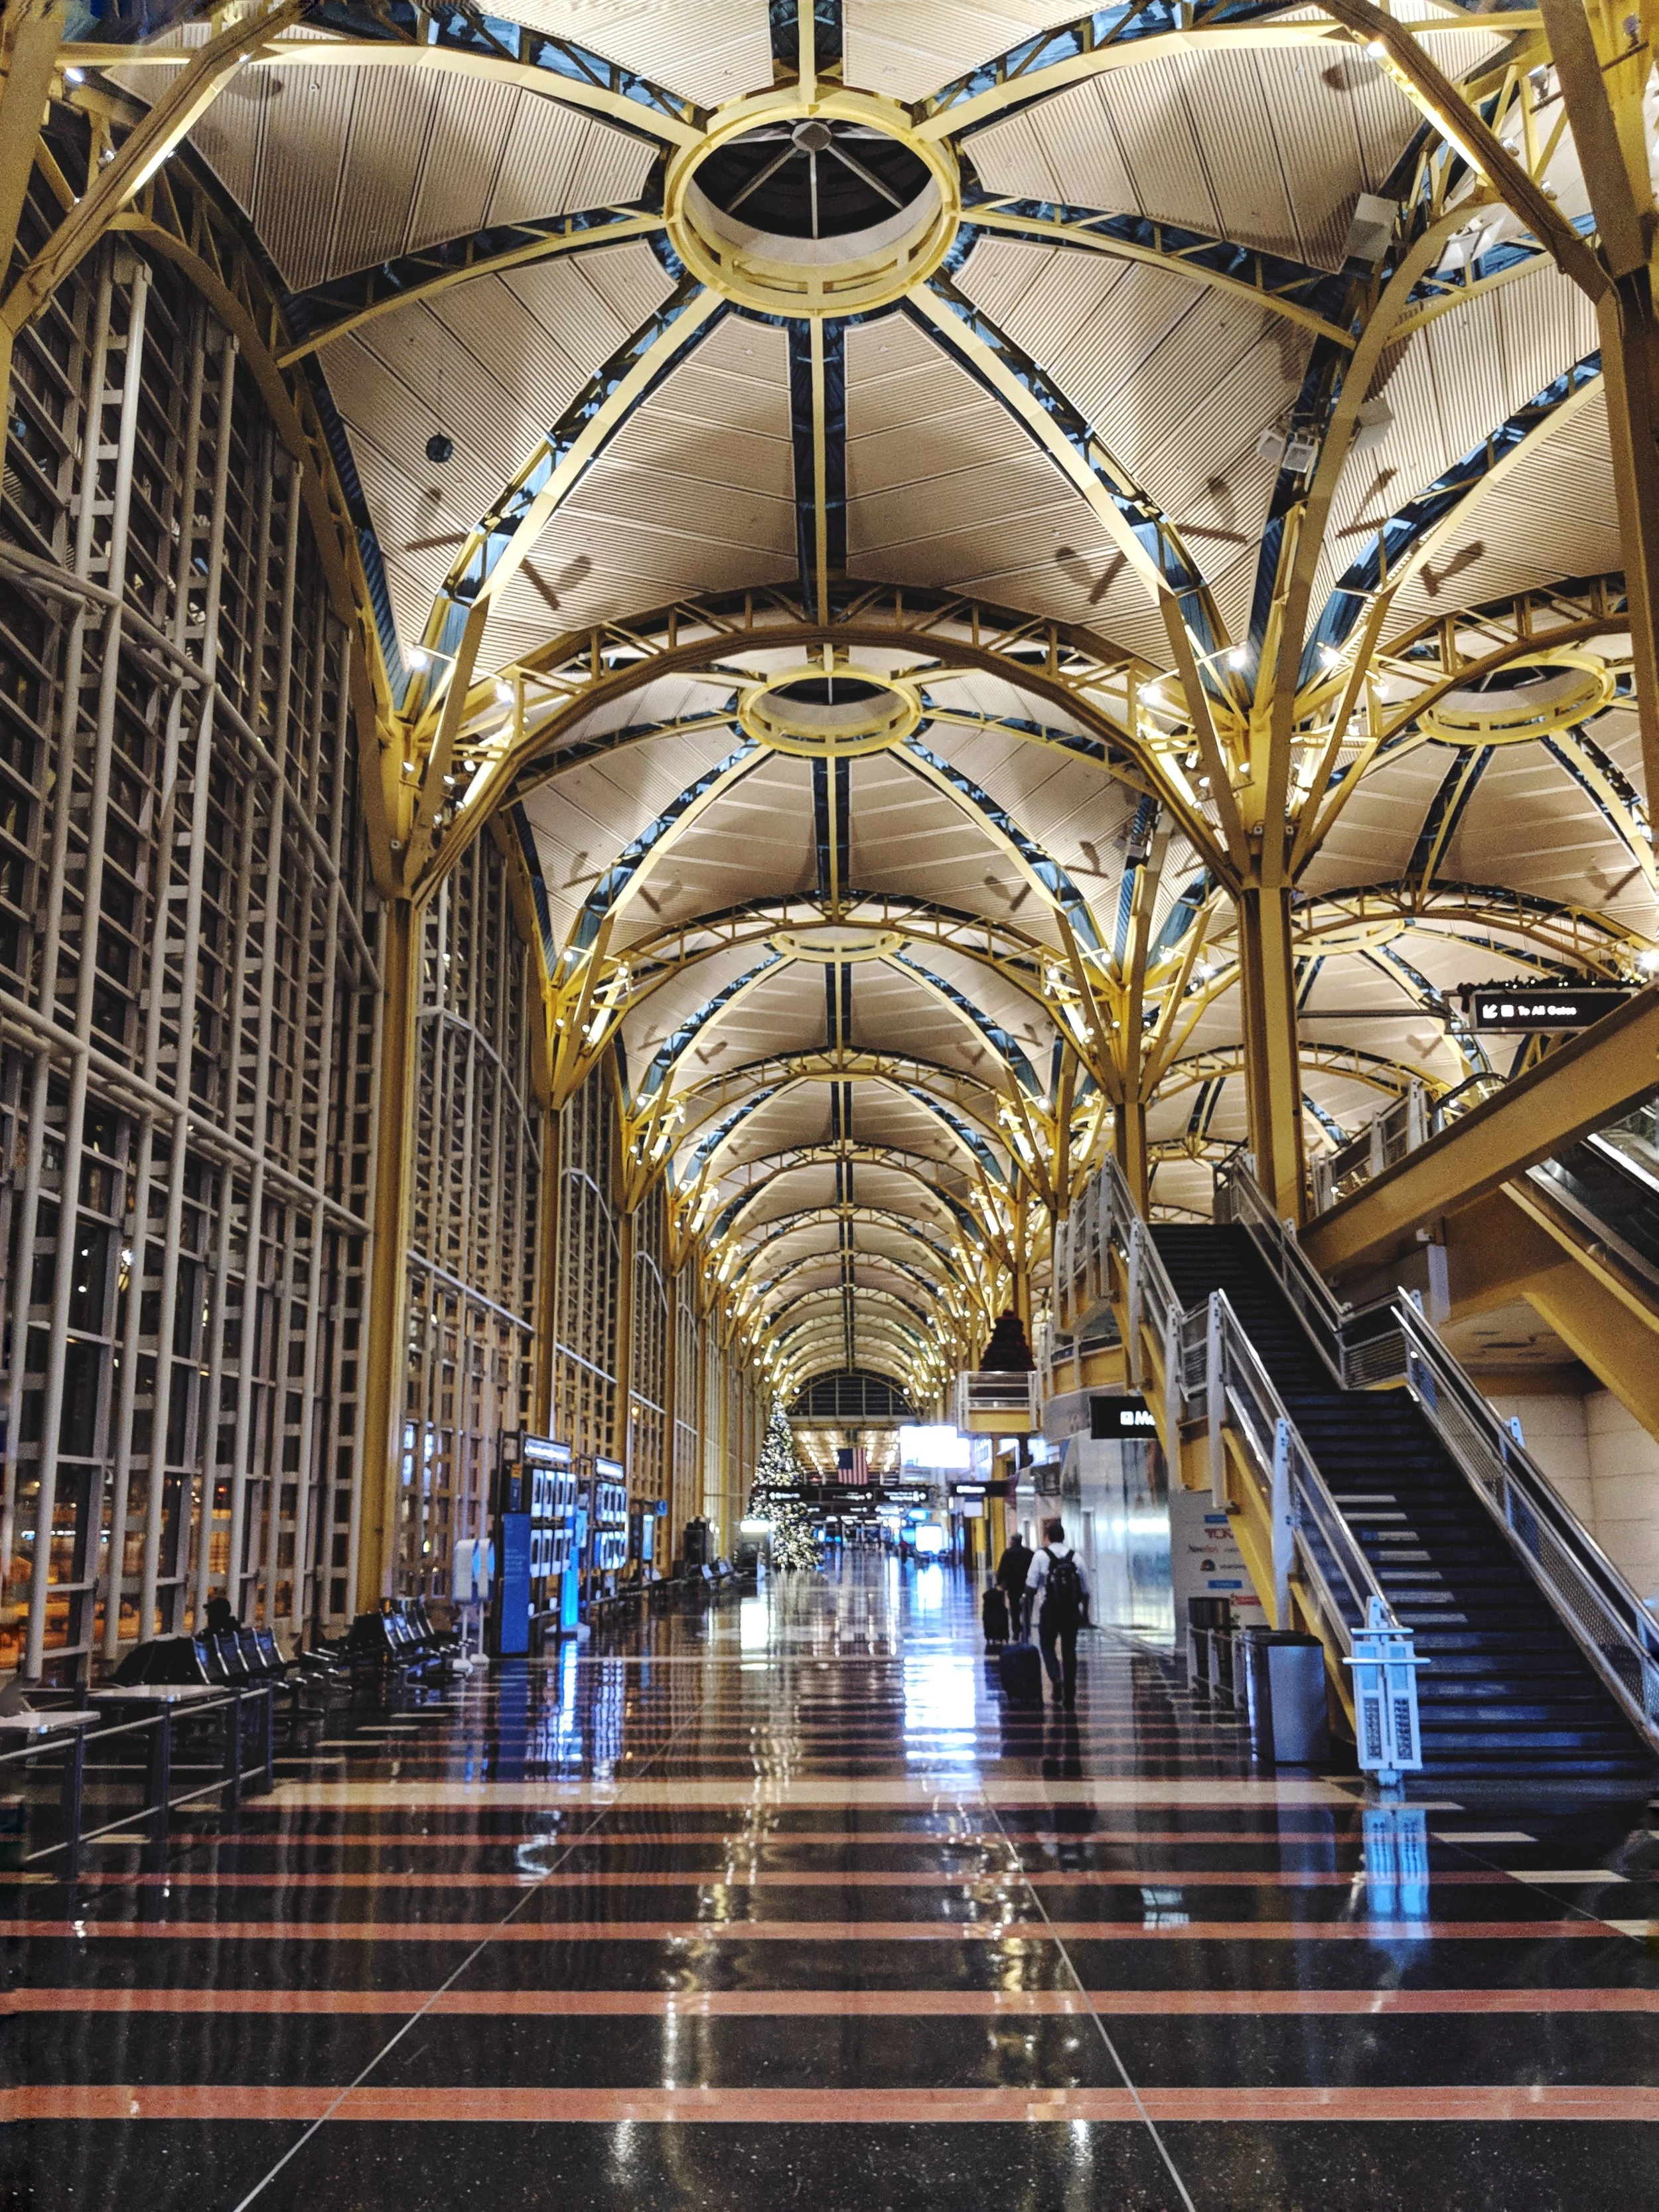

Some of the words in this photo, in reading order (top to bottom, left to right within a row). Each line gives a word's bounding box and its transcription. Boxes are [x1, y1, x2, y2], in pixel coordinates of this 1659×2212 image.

[1518, 1005, 1530, 1015] To
[1532, 1005, 1546, 1015] All
[1547, 1005, 1577, 1015] Gates
